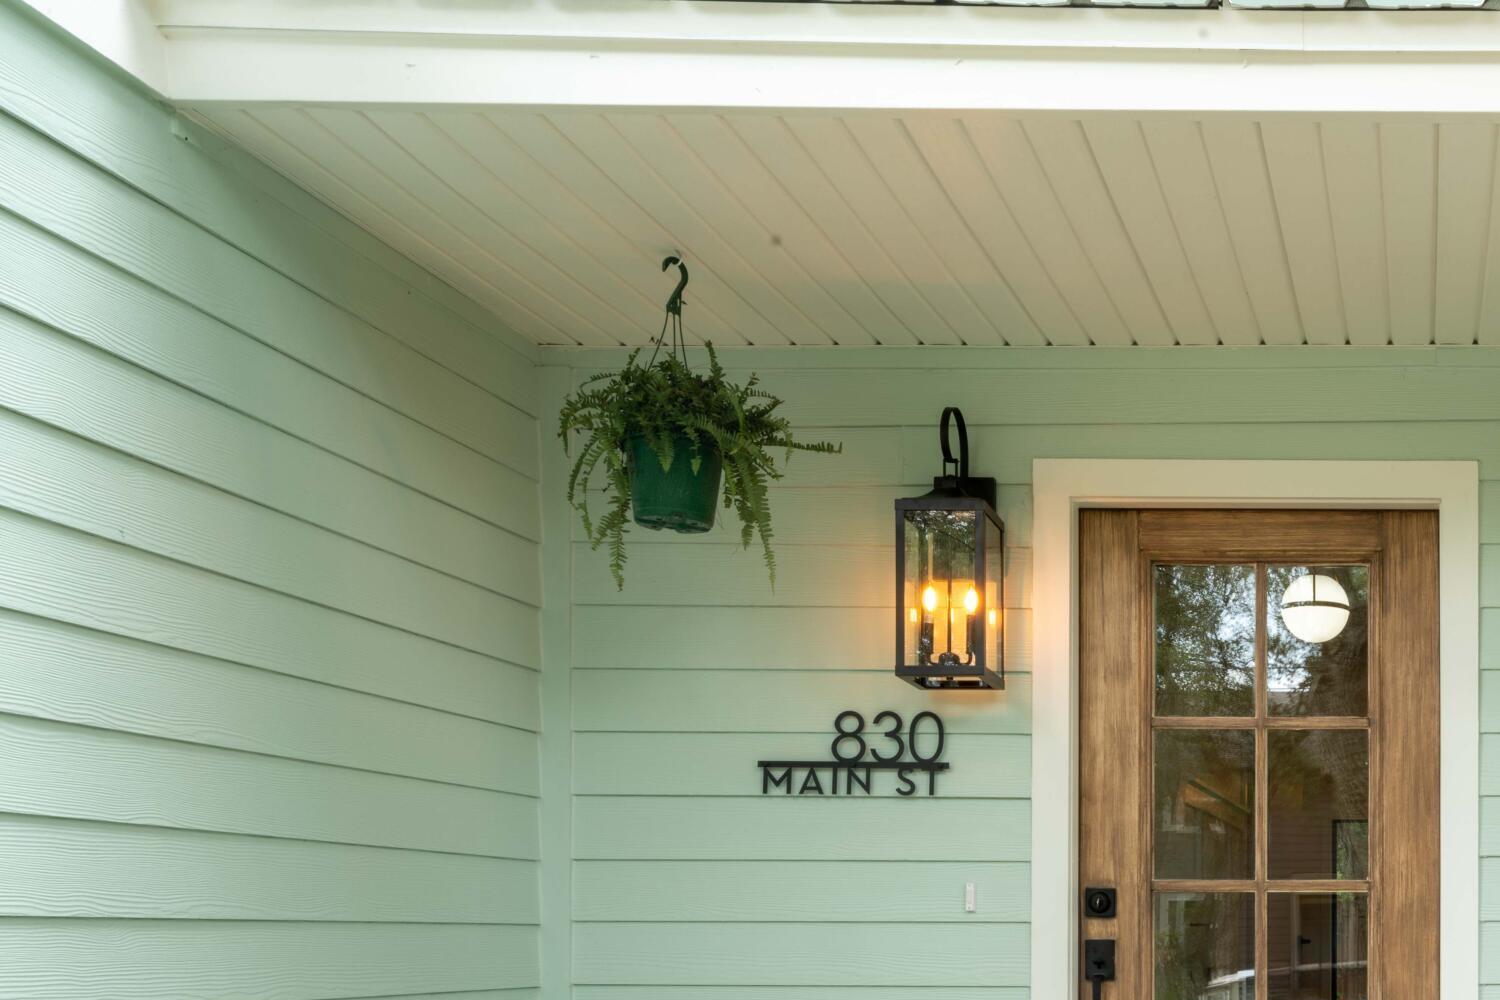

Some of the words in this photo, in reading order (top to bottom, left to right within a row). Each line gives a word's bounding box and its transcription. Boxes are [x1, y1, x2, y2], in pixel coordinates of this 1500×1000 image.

[831, 710, 945, 764] 830
[762, 766, 871, 795] MAIN
[895, 766, 943, 796] ST
